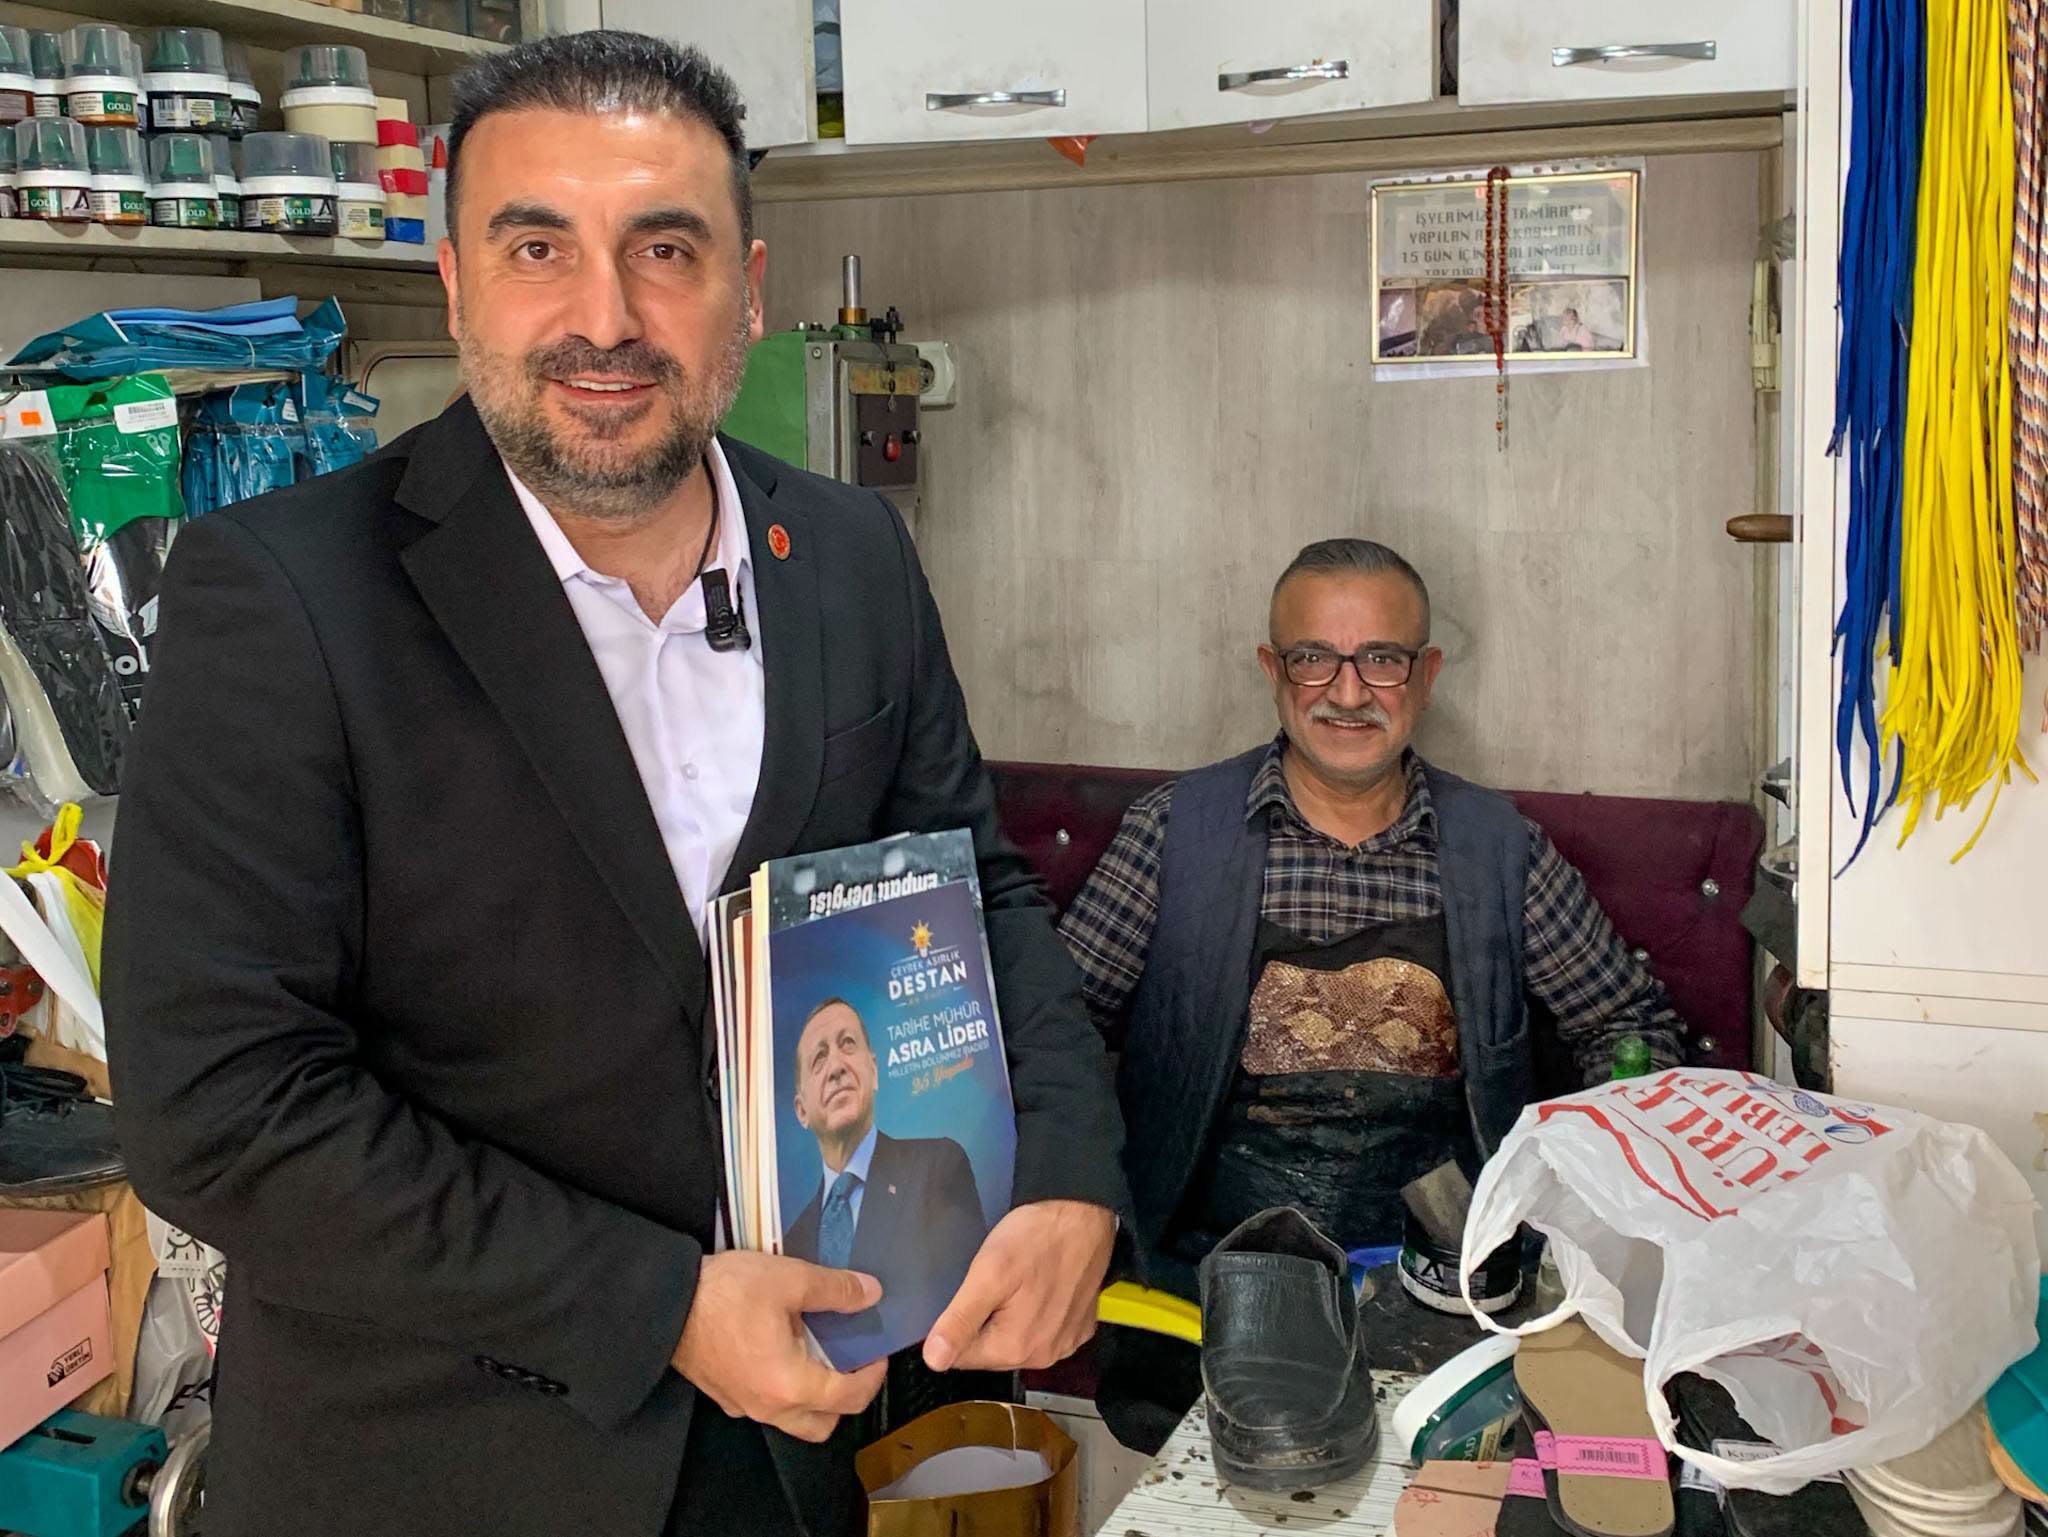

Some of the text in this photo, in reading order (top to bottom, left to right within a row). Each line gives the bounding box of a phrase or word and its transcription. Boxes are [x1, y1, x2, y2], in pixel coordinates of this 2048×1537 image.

[106, 101, 132, 112] GOLD
[1402, 250, 1419, 264] 15
[888, 960, 968, 1001] DESTAN
[887, 1019, 990, 1068] ASRA LİDER
